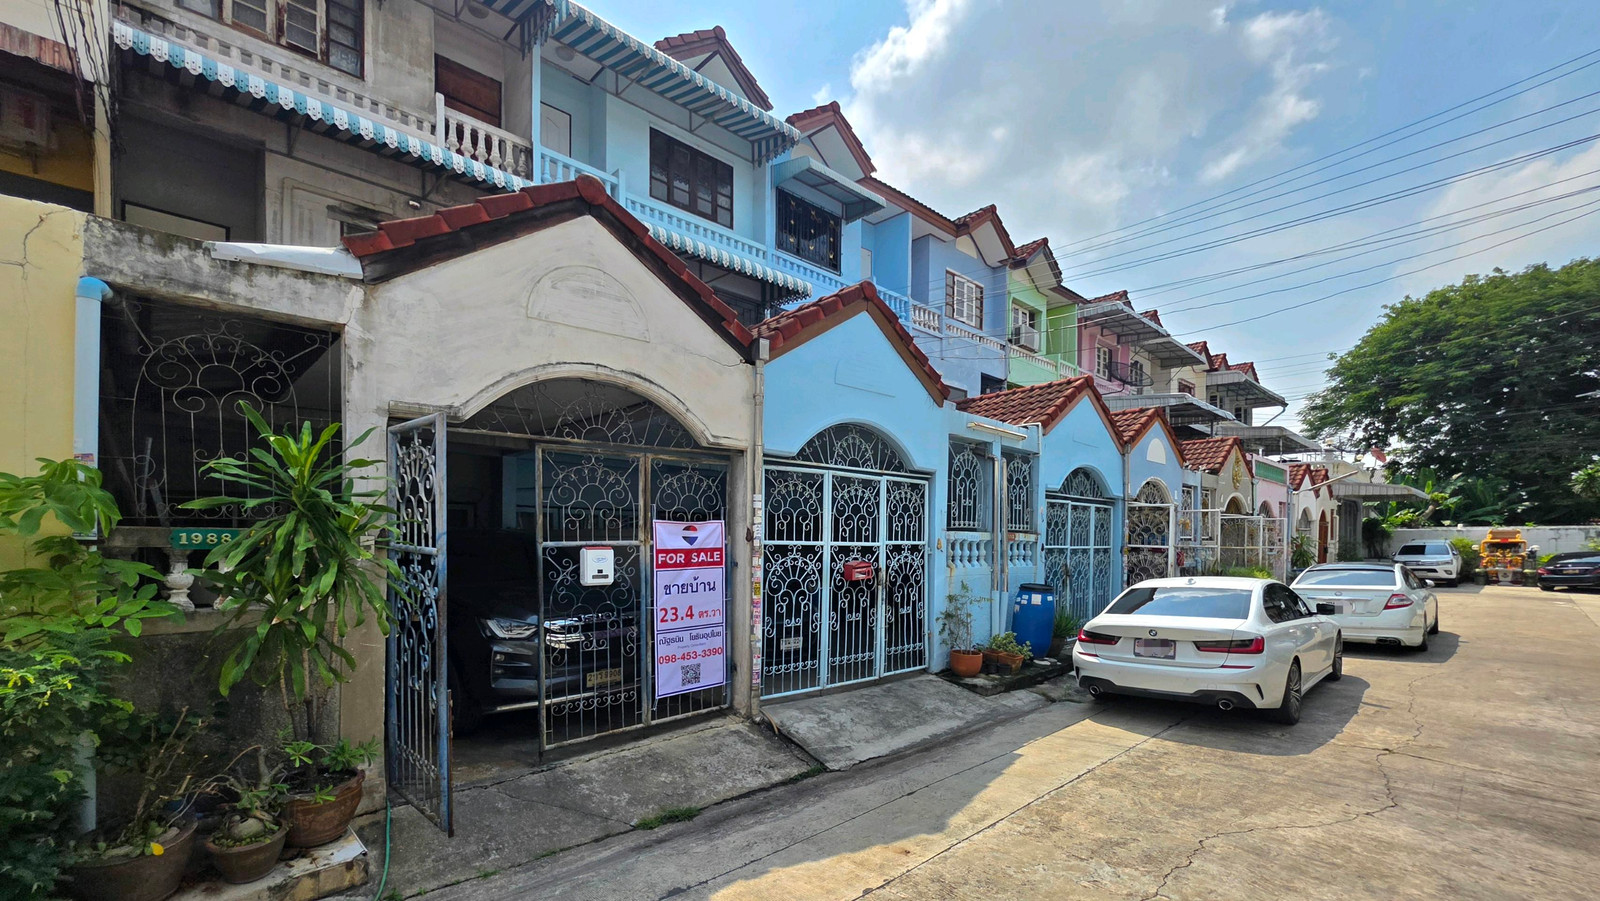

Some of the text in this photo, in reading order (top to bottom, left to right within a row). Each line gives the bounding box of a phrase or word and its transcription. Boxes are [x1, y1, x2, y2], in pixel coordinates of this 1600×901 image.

[179, 532, 232, 545] 1988
[658, 552, 721, 564] FOR SALE
[663, 576, 716, 595] ขายบ้าน
[659, 604, 694, 623] 23.4
[658, 647, 723, 664] 098-453-3390
